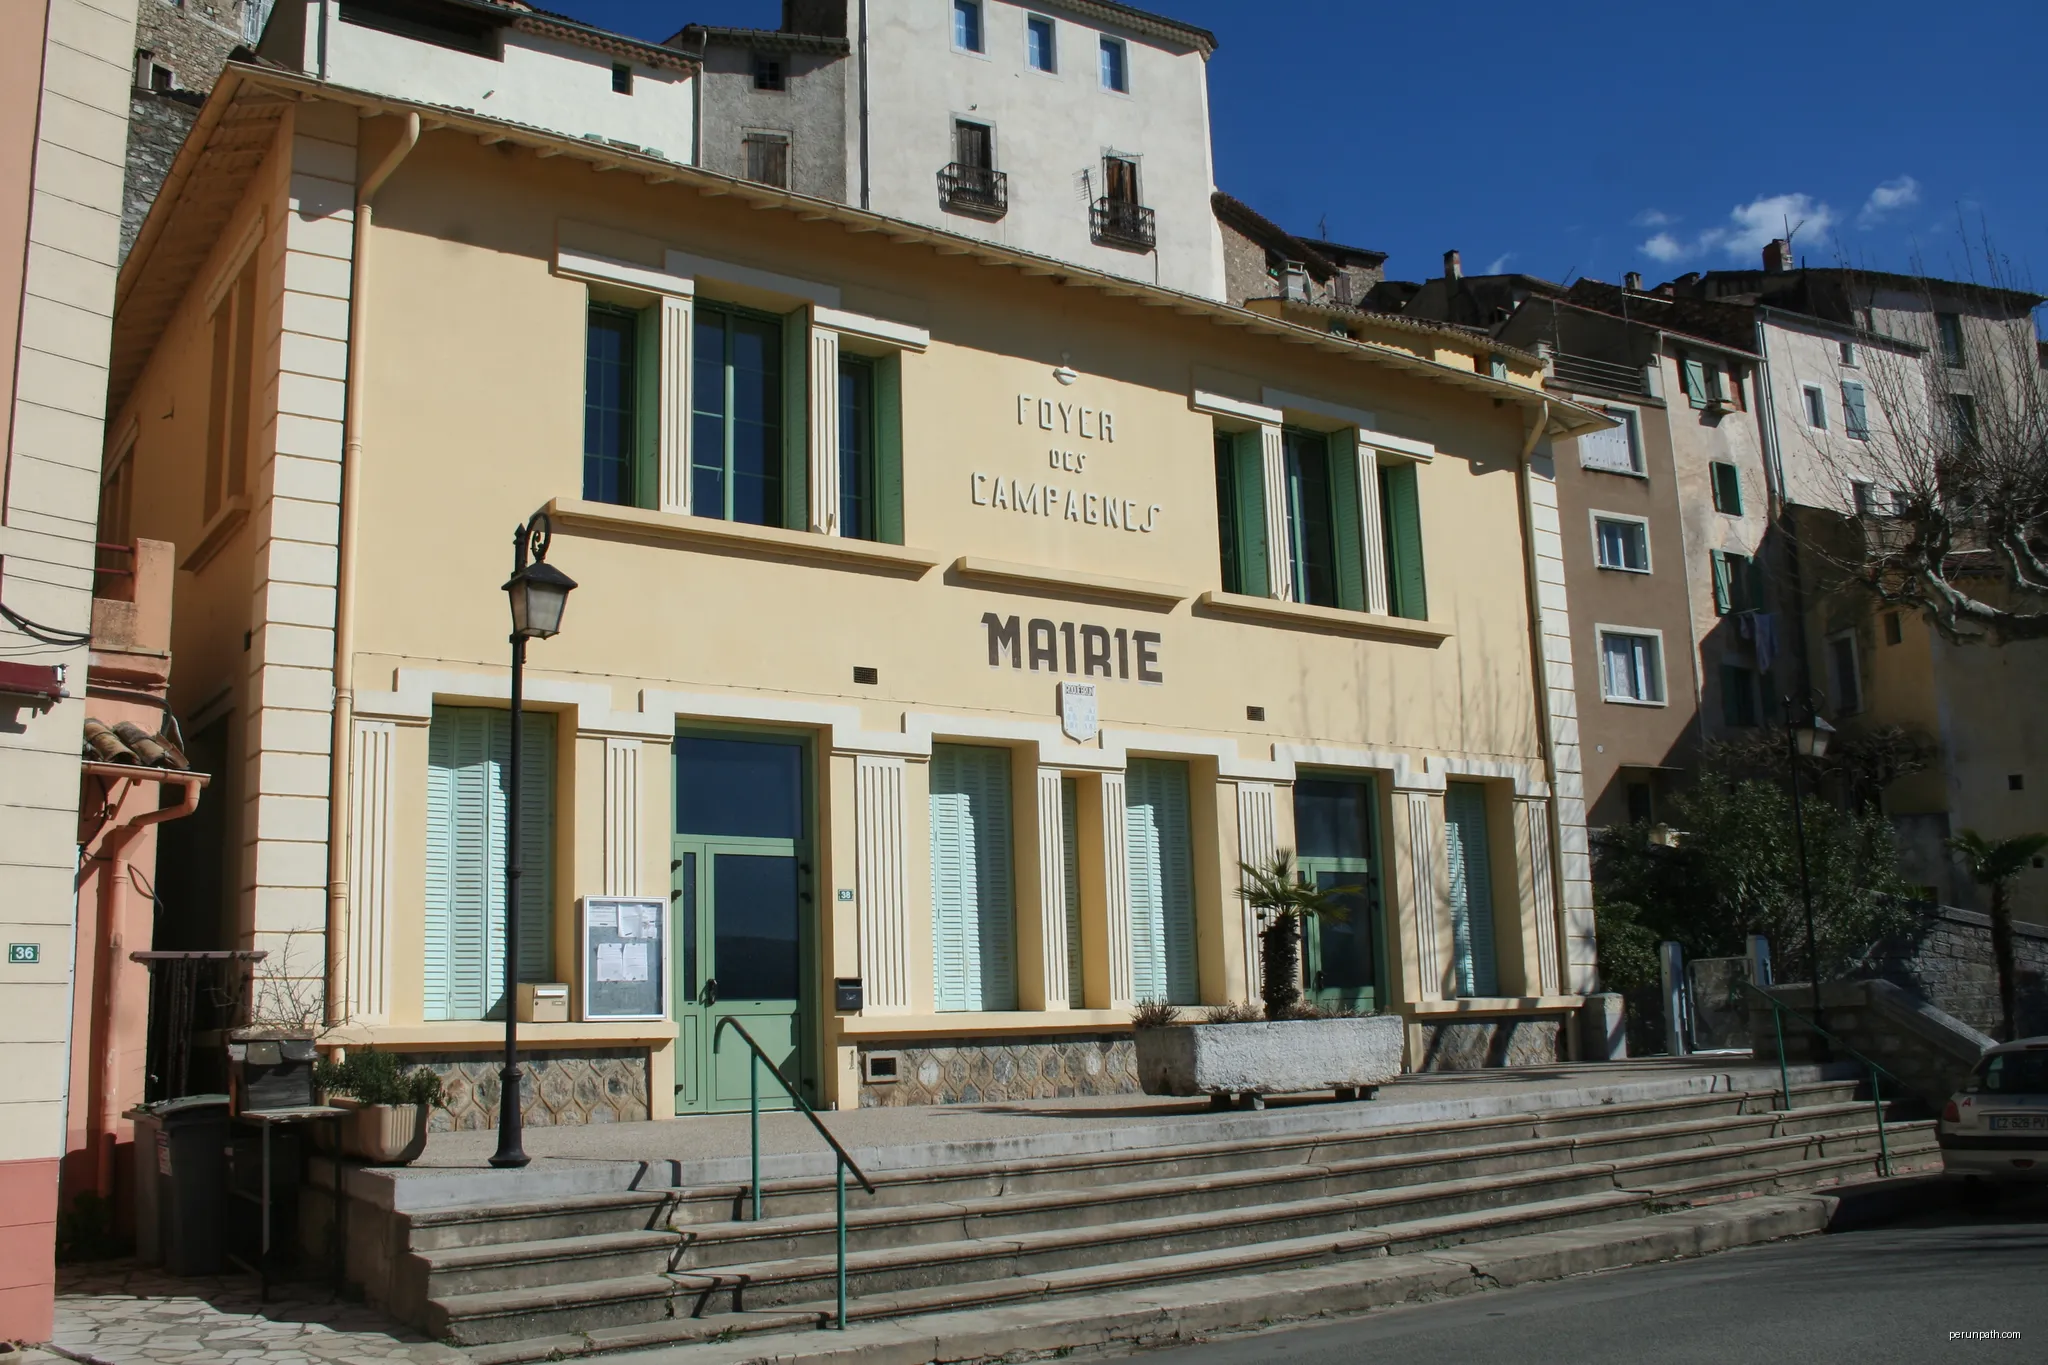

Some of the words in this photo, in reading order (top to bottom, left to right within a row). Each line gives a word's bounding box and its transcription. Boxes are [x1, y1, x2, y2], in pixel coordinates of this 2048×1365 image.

[1017, 393, 1115, 443] FOYER
[1049, 448, 1086, 473] DES
[971, 472, 1162, 532] CAMPAGNES
[980, 612, 1163, 684] MAIRIE
[841, 891, 851, 899] 38
[16, 947, 34, 959] 36
